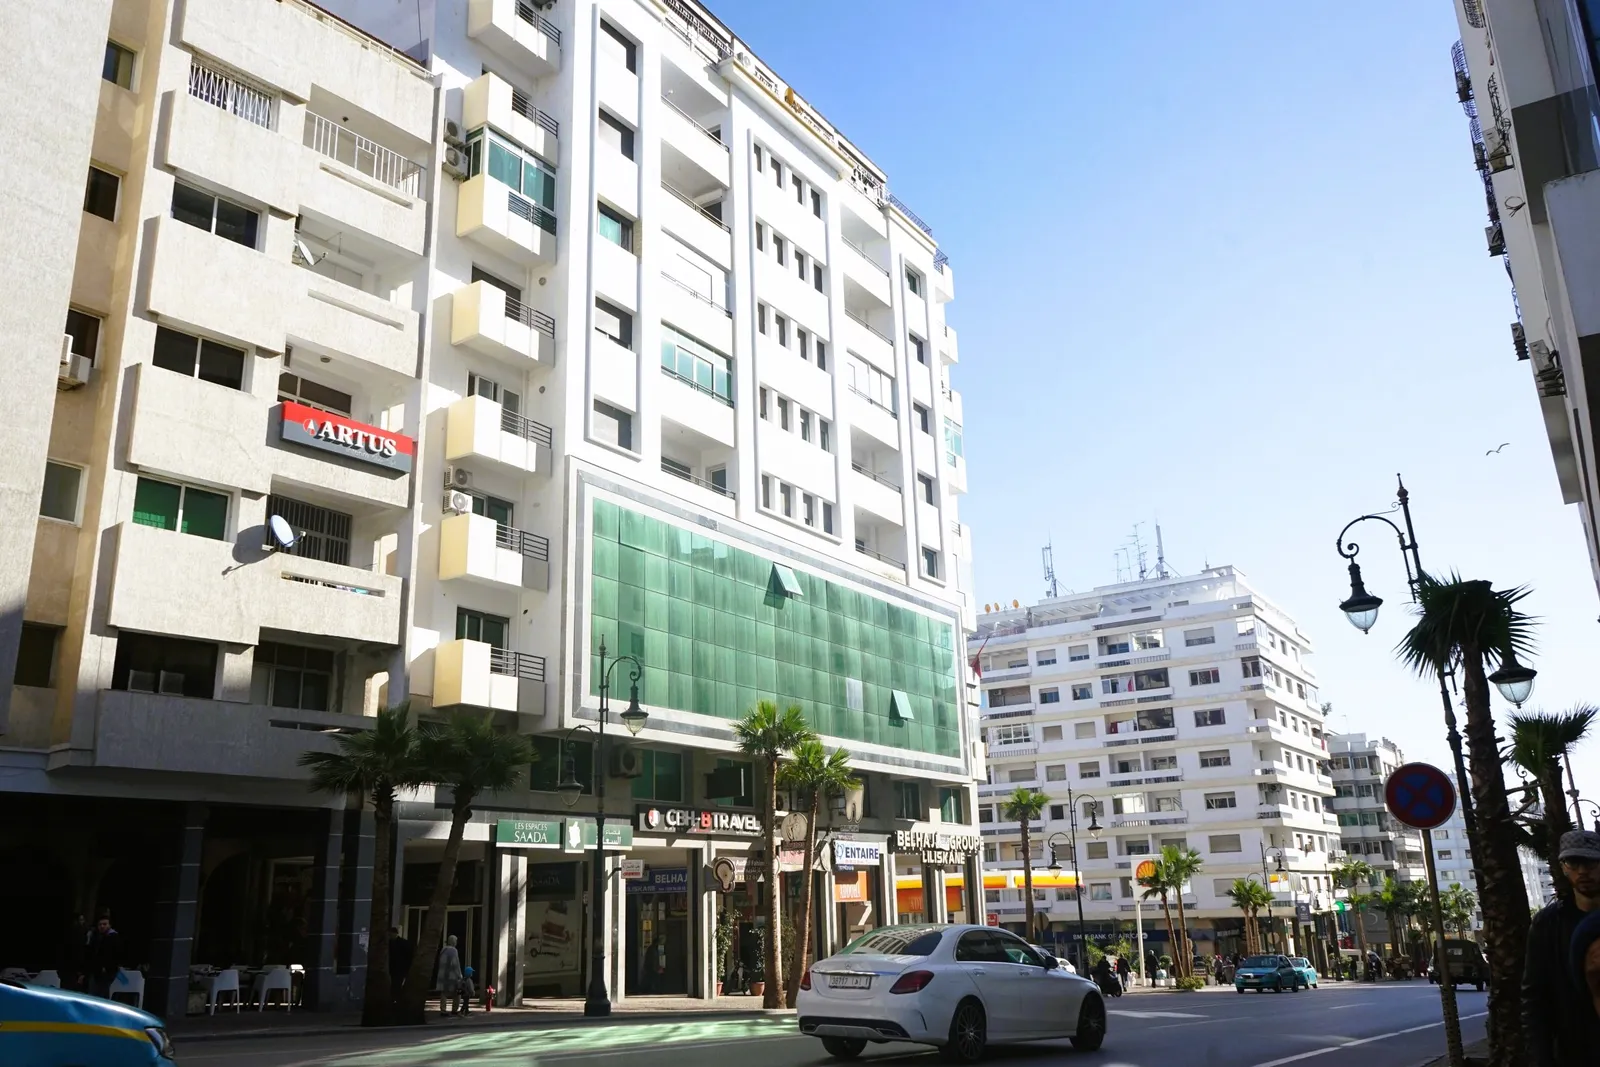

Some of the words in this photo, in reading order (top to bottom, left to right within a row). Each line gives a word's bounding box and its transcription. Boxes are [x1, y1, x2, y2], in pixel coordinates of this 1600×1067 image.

[318, 420, 397, 457] ARTUS
[514, 822, 524, 830] LES
[525, 823, 548, 831] ESPACES
[514, 831, 548, 843] SAADA
[897, 830, 937, 849] BELHAJ
[948, 835, 985, 852] GROUPE
[922, 850, 966, 864] LILISKANE
